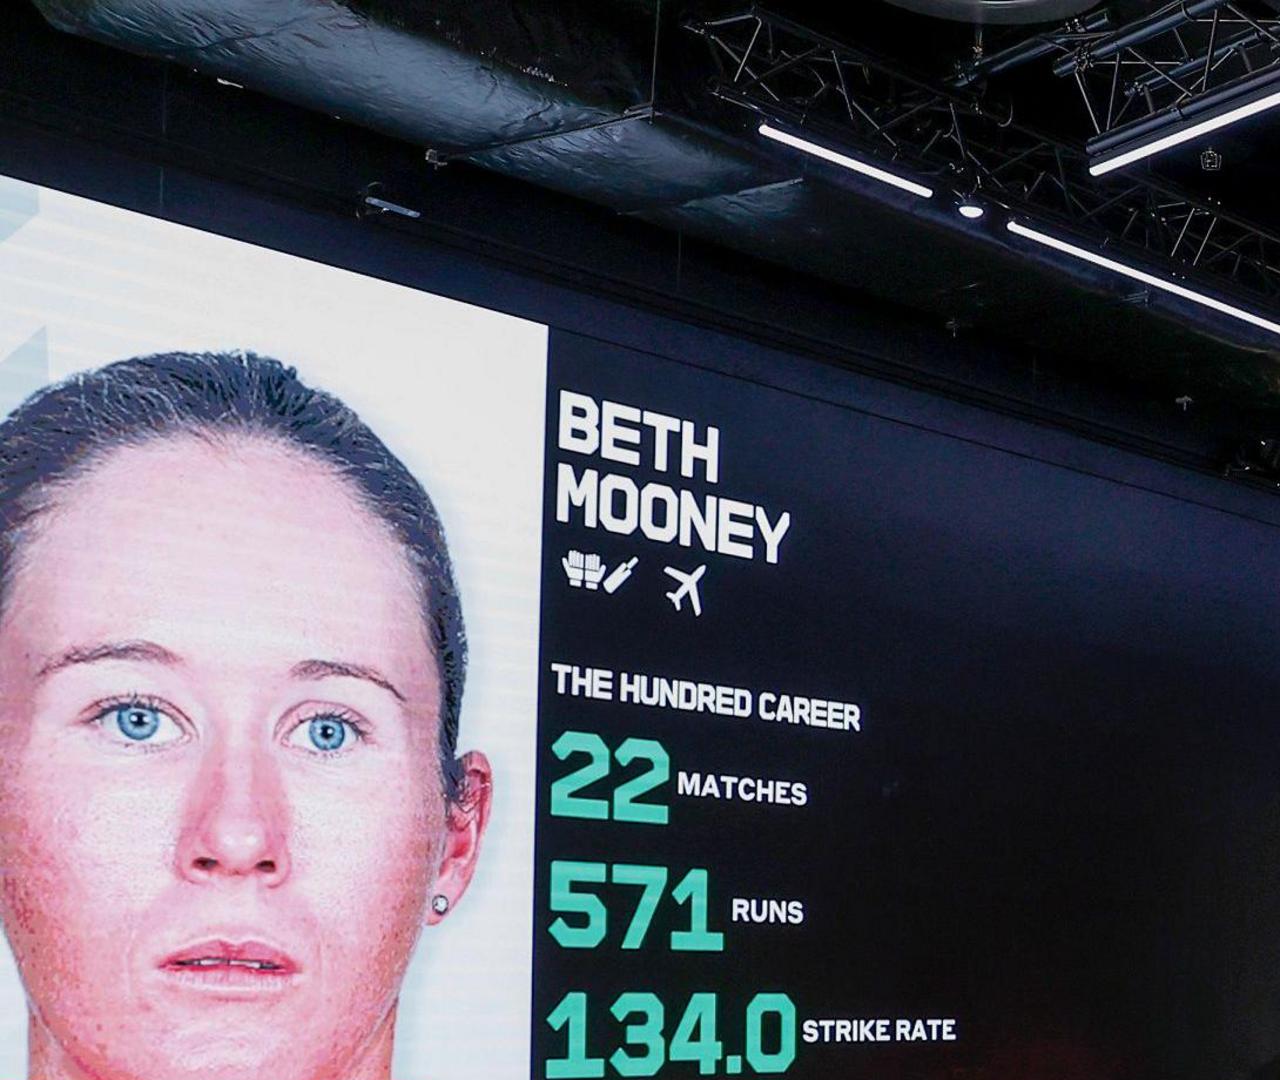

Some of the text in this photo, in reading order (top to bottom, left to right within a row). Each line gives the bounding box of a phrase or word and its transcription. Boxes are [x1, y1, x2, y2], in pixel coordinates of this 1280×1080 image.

[559, 389, 719, 483] BETH
[556, 463, 790, 563] MOONEY
[551, 663, 861, 732] THE HUNDRED CAREER
[551, 731, 808, 825] 22 MATCHES
[548, 860, 804, 952] 571 RUNS
[545, 992, 956, 1079] 134.0 STRIKE RATE
